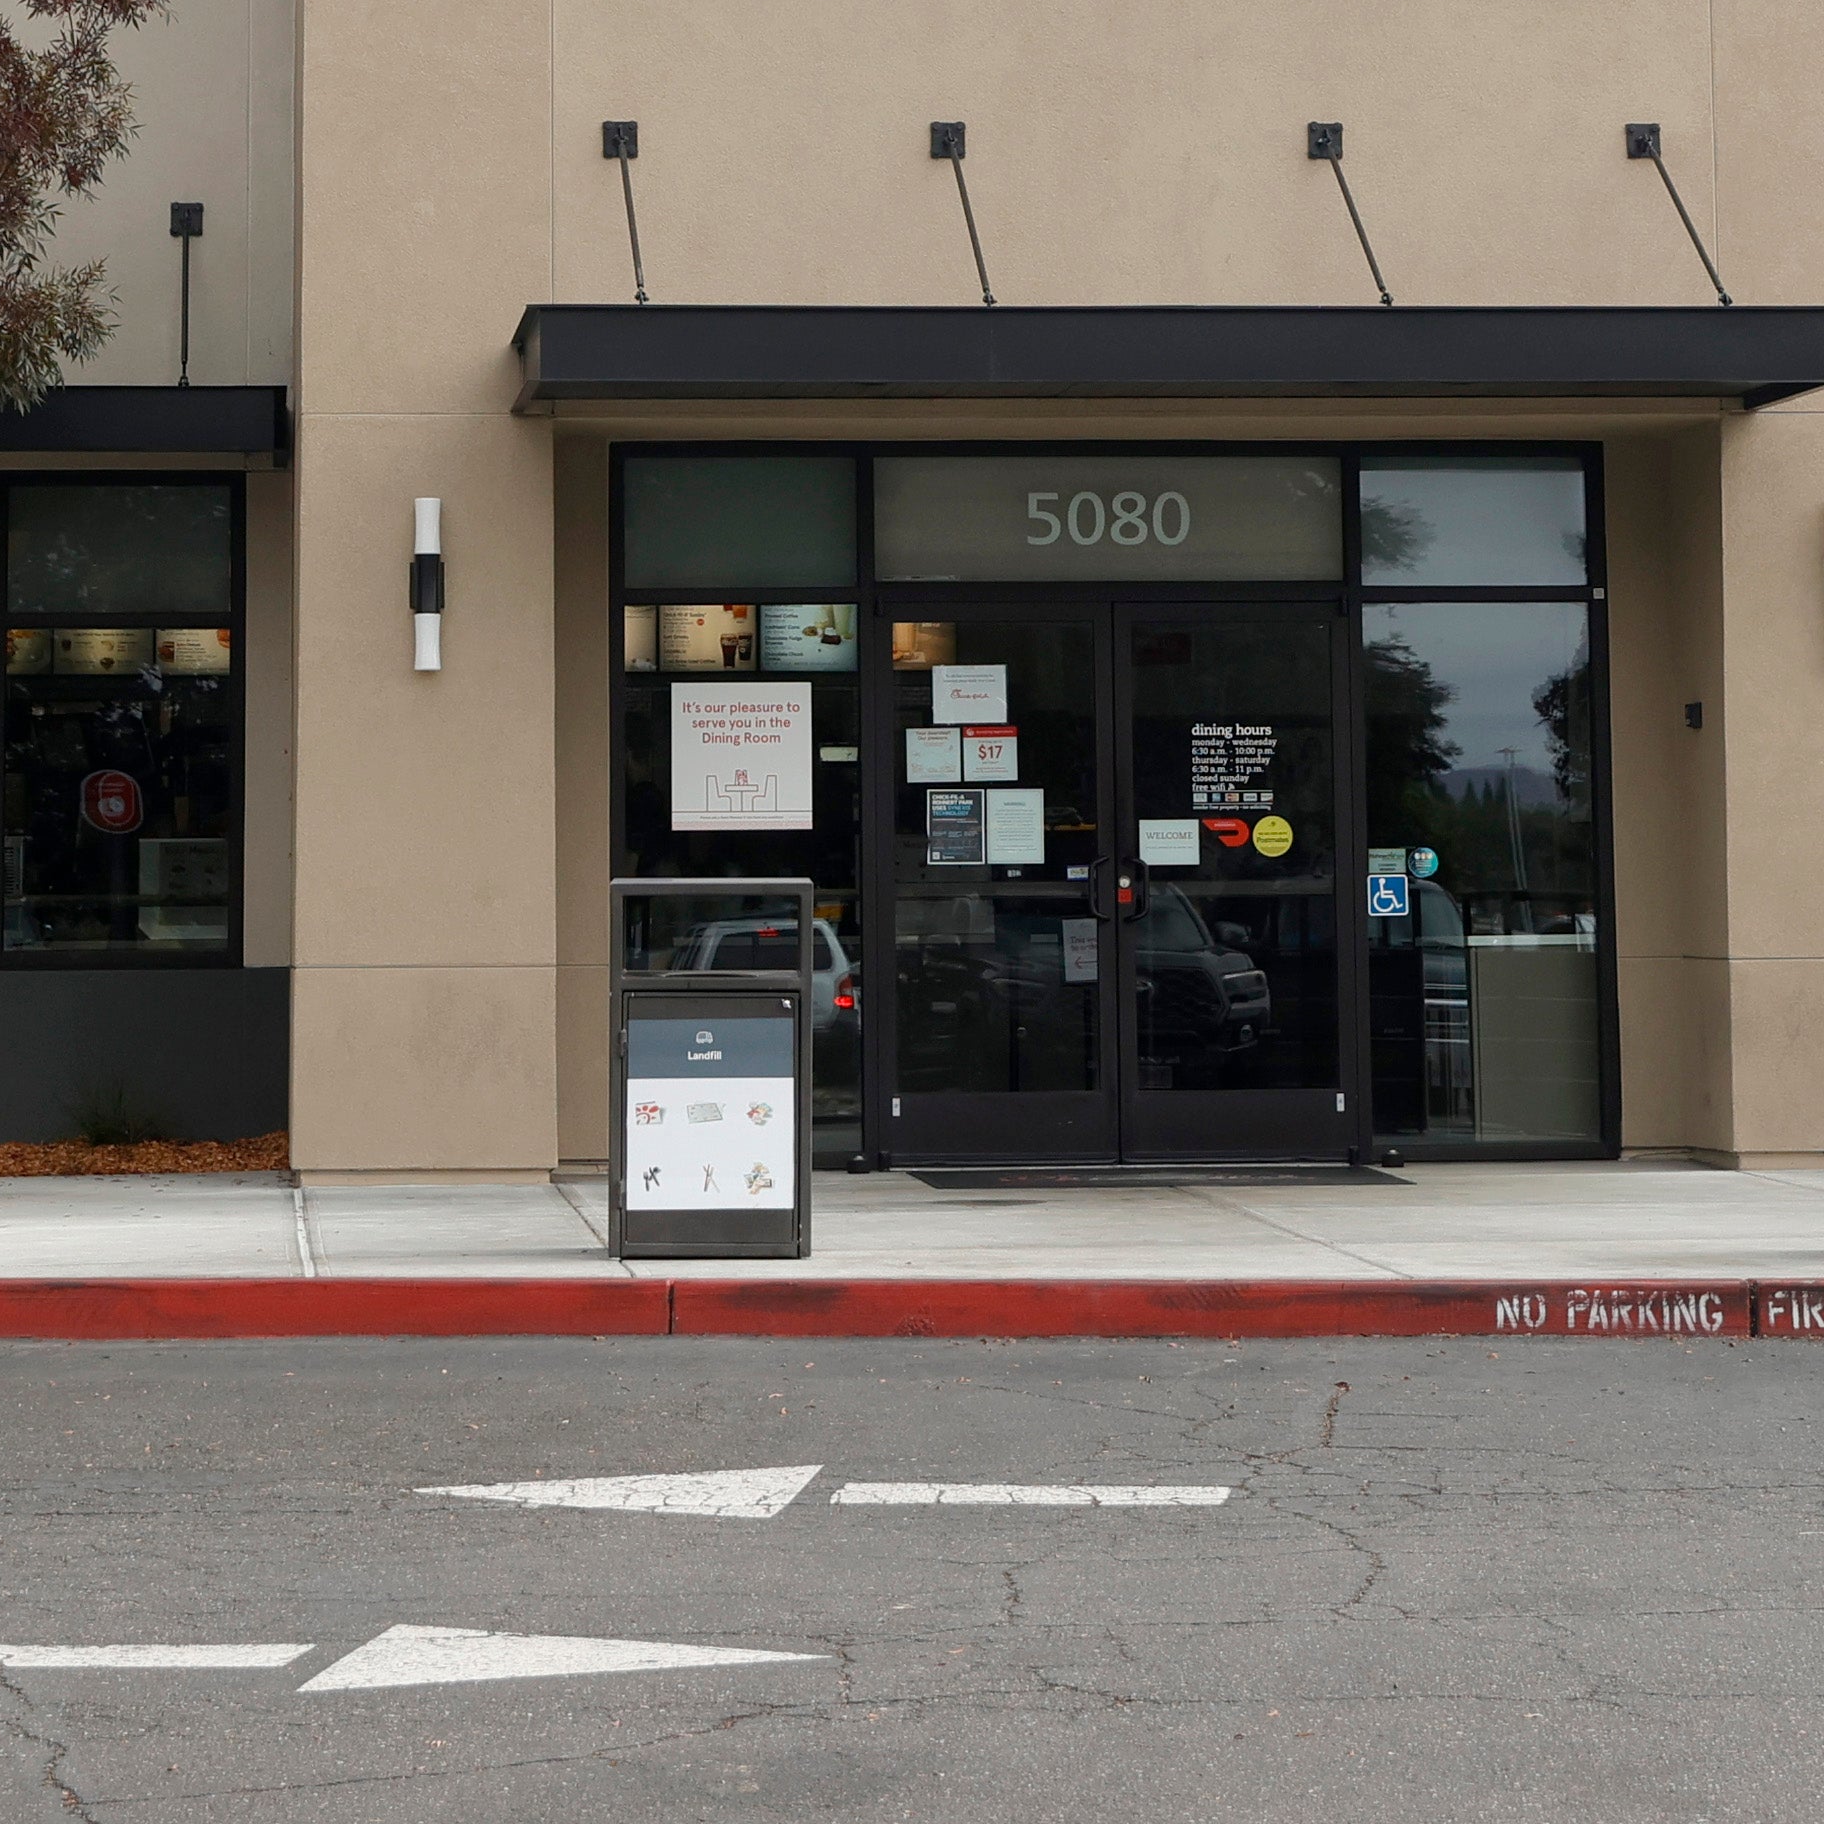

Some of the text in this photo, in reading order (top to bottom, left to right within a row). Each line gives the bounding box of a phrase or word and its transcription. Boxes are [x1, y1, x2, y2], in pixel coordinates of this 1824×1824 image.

[1026, 490, 1191, 546] 5080
[682, 701, 801, 716] It’s our pleasure to
[691, 716, 792, 731] serve you in the
[1191, 723, 1272, 738] dining hours
[702, 732, 782, 746] Dining Room
[1192, 738, 1226, 748] monday
[1232, 738, 1277, 748] wednesday
[978, 743, 1003, 760] $17
[1192, 747, 1209, 755] 6:30
[1235, 747, 1256, 755] 10:00
[1256, 748, 1276, 757] p.m.
[1192, 756, 1229, 766] thursday
[1235, 756, 1271, 766] saturday
[1192, 765, 1209, 773] 6:30
[1235, 765, 1245, 773] 11
[1245, 766, 1265, 774] p.m.
[1192, 774, 1250, 784] closed sunday
[1192, 783, 1226, 792] free wifi
[1145, 831, 1194, 840] WELCOME
[687, 1050, 722, 1061] Landfill
[1494, 1293, 1547, 1330] NO
[1566, 1288, 1724, 1332] PARKING
